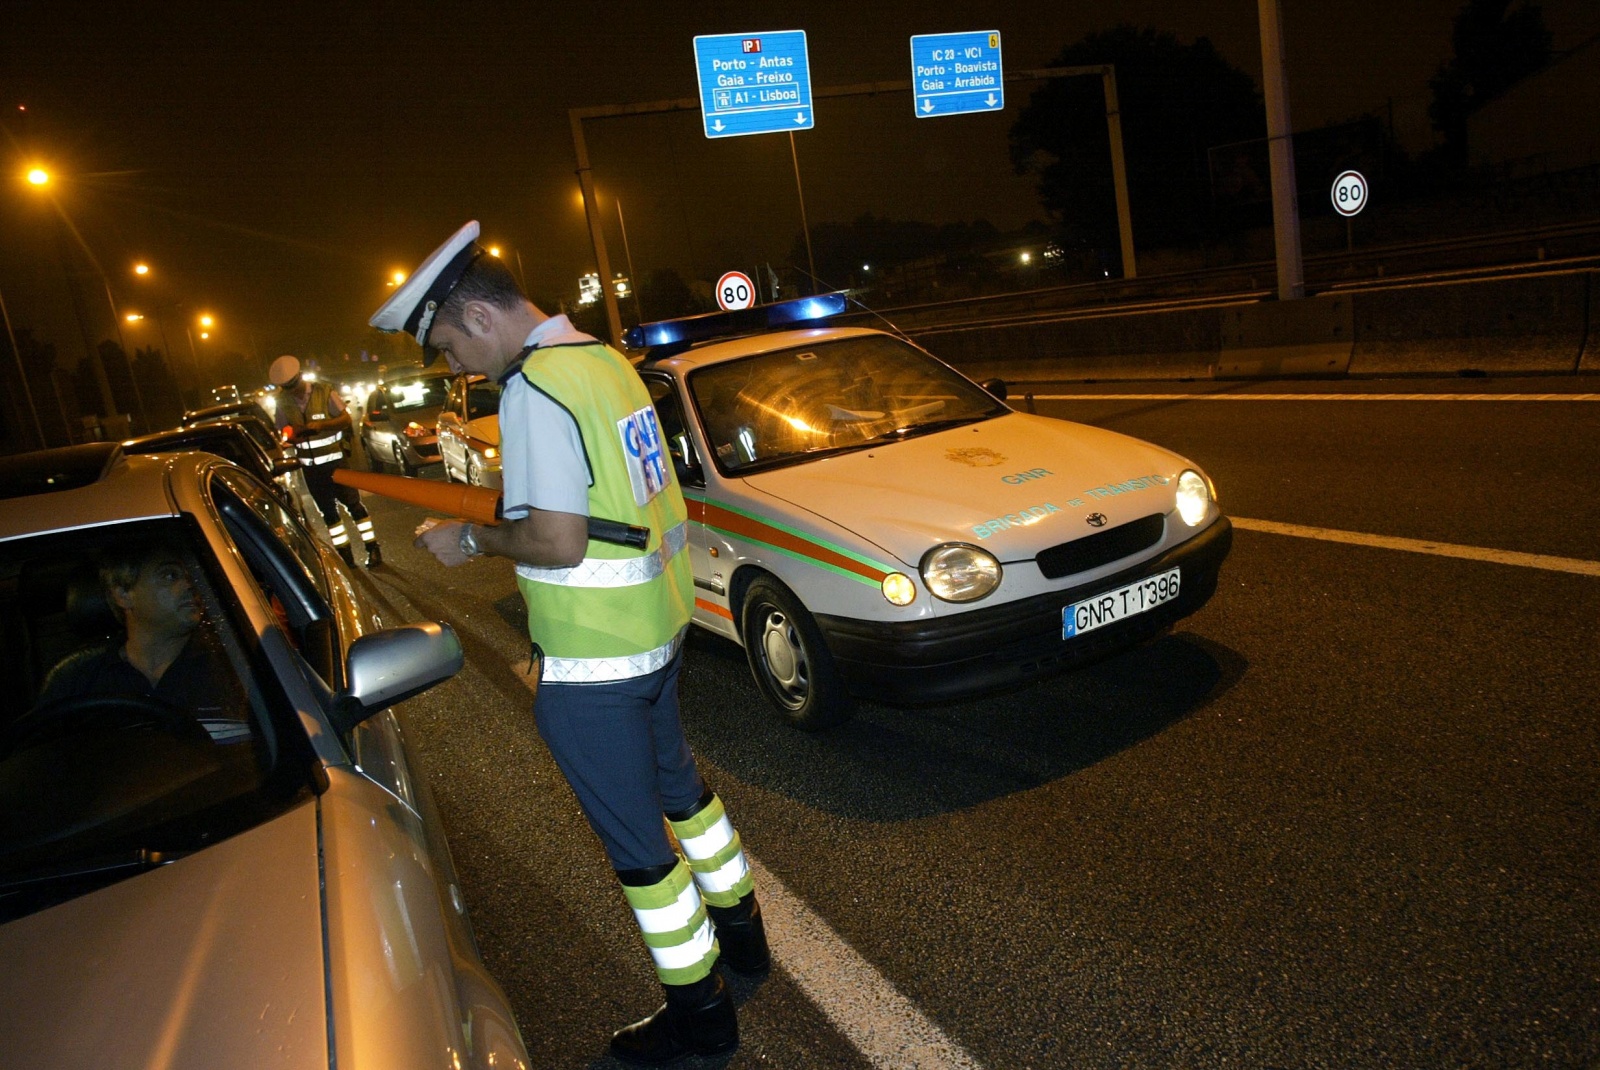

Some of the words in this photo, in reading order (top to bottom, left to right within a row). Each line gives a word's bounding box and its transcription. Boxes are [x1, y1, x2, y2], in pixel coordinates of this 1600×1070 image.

[742, 40, 754, 53] IP
[932, 49, 943, 61] IC
[944, 48, 955, 60] 23
[964, 47, 982, 59] VCI
[712, 58, 747, 71] Porto
[759, 55, 794, 68] Antas
[917, 65, 946, 77] Porto
[954, 60, 998, 74] Boavista
[717, 73, 744, 87] Gaia
[756, 71, 793, 84] Freixo
[921, 79, 944, 91] Gaia
[954, 74, 995, 88] Arrábida
[735, 91, 749, 104] A1
[759, 89, 797, 102] Lisboa
[1338, 184, 1361, 203] 80
[723, 284, 749, 304] 80
[1001, 467, 1055, 487] GNR
[972, 502, 1063, 539] BRIGADA
[1075, 596, 1115, 631] GNR
